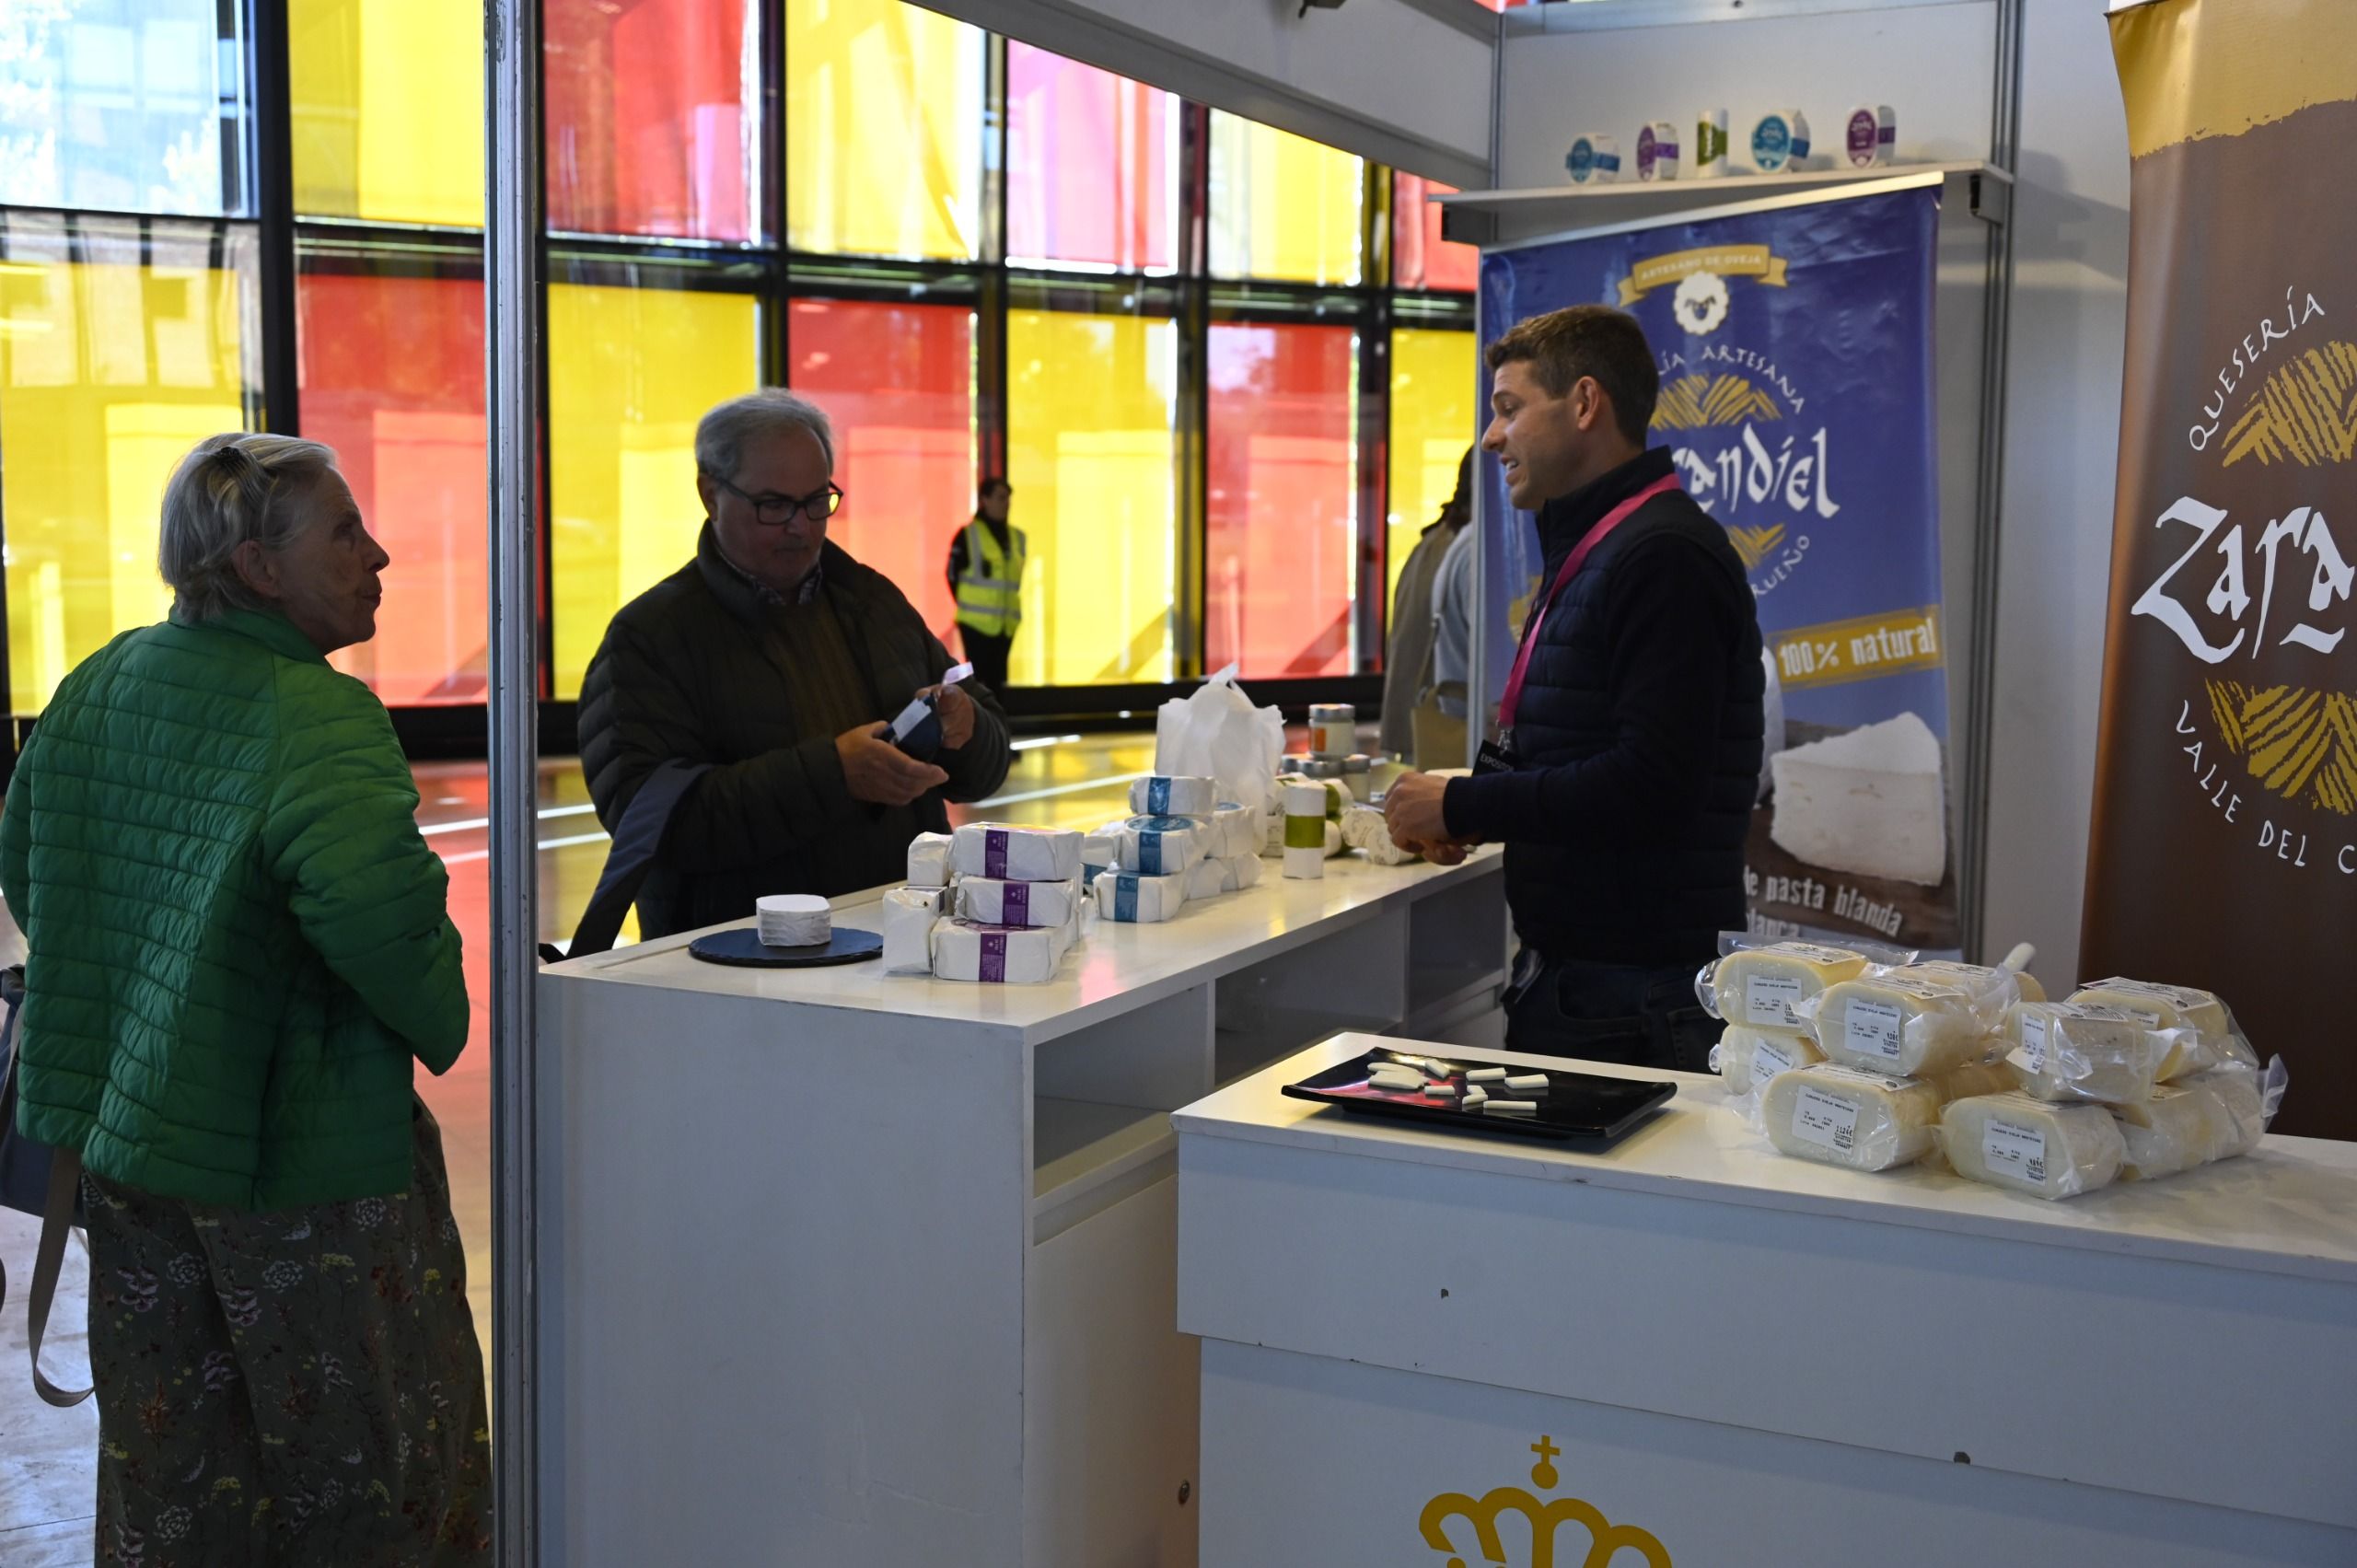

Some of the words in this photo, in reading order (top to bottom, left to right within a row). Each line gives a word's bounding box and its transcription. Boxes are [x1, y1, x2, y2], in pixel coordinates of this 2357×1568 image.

[1642, 258, 1702, 280] ARTESANO
[1705, 256, 1719, 265] DE
[1724, 255, 1761, 264] OVEJA
[1701, 344, 1805, 413] ARTESANA
[2189, 285, 2326, 451] QUESERÍA
[2131, 496, 2355, 664] Zara
[1780, 641, 1840, 678] 100%
[1851, 617, 1937, 666] natural
[2176, 700, 2242, 823] VALLE
[2258, 819, 2306, 867] DEL
[1765, 876, 1827, 910] pasta
[1833, 884, 1903, 938] blanda
